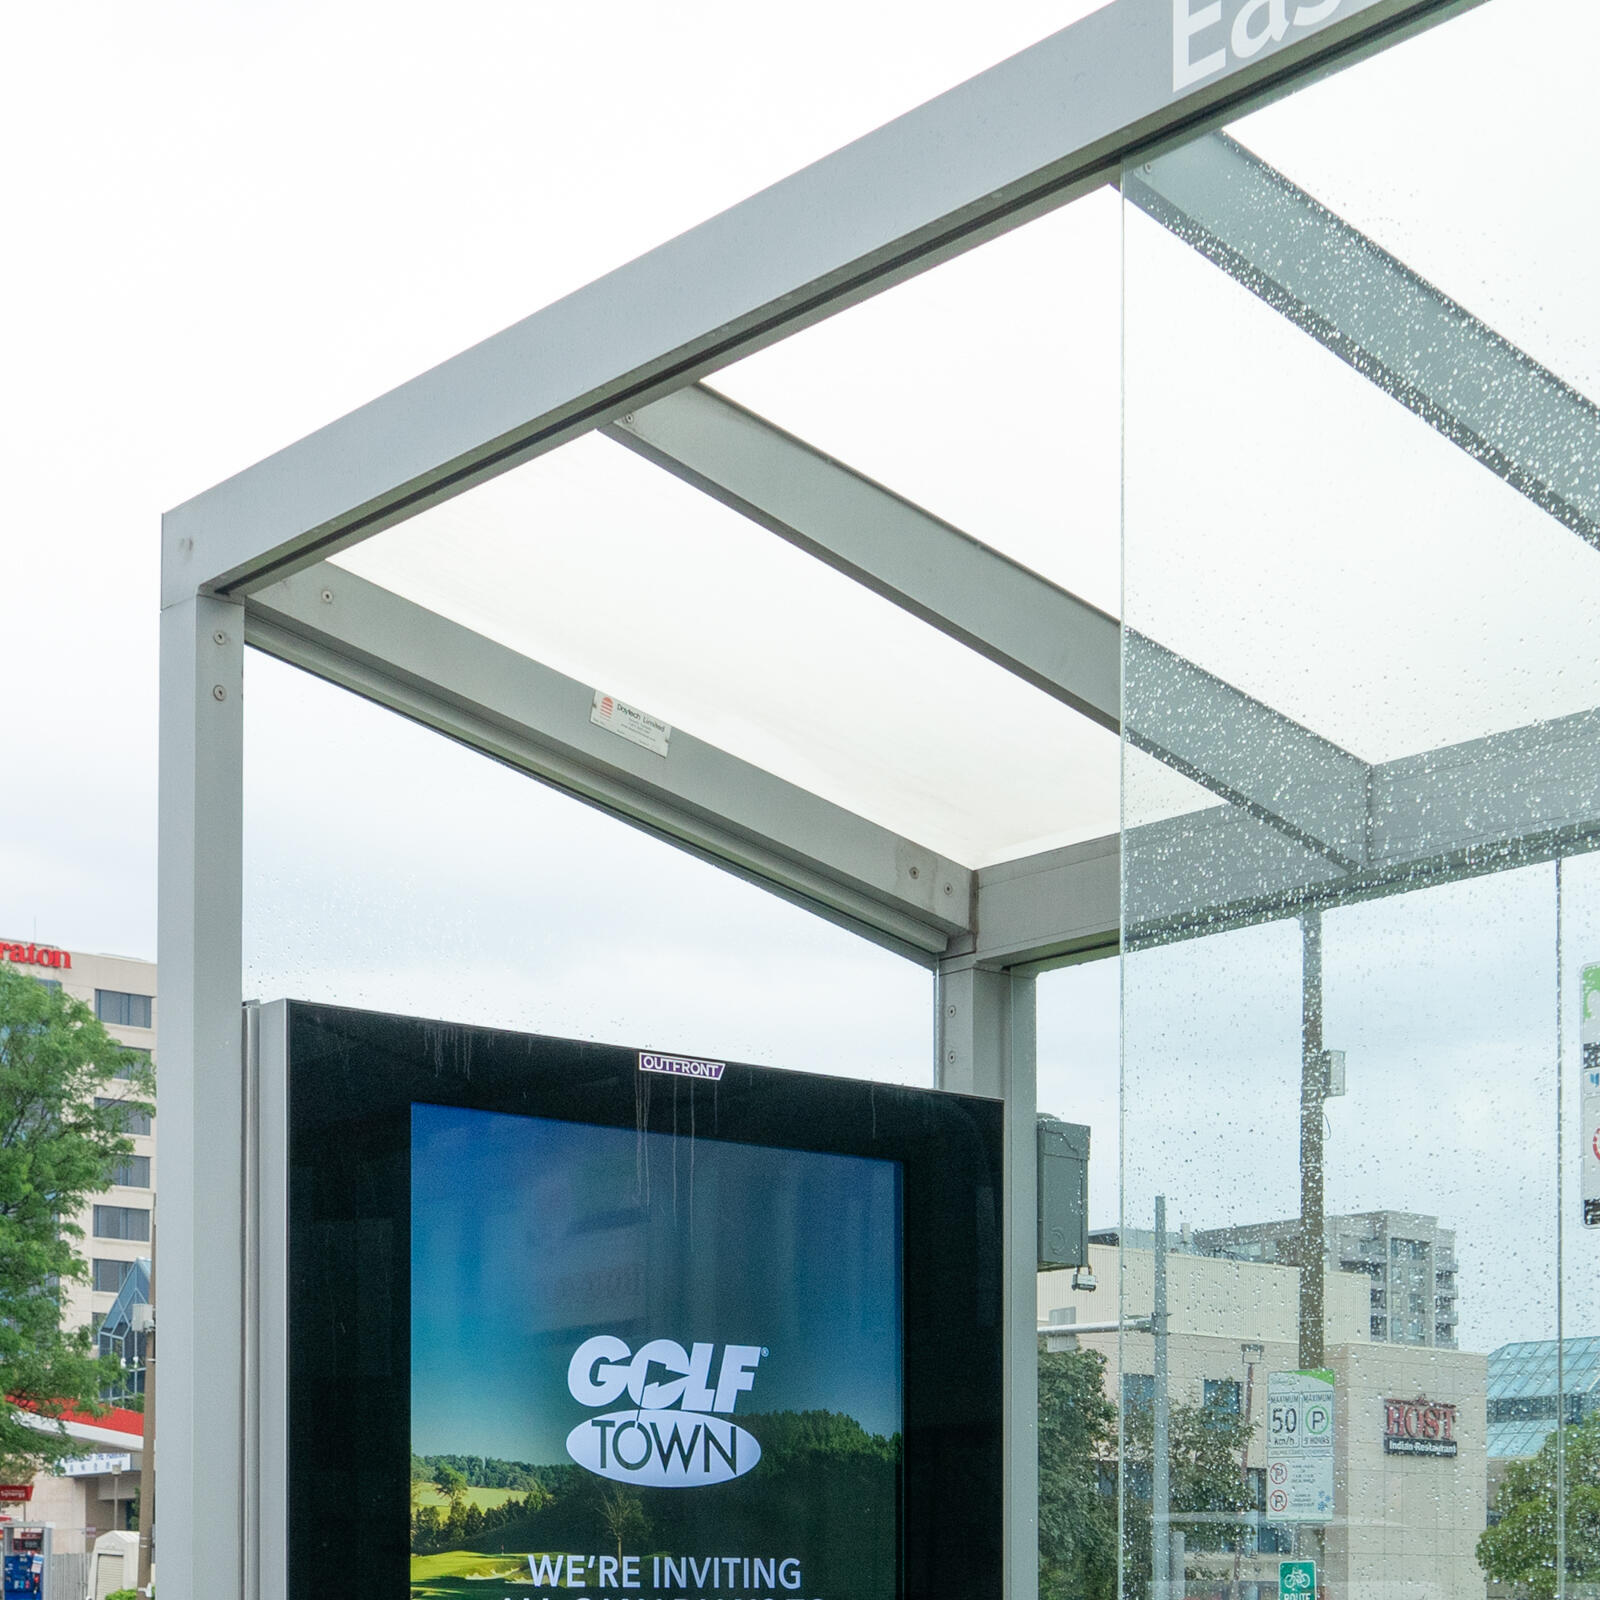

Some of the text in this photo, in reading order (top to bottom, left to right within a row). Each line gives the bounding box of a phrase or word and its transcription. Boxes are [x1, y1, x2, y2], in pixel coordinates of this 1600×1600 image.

[643, 1056, 719, 1077] OUTFRONT
[568, 1335, 761, 1413] GOLF
[1272, 1407, 1297, 1434] 50
[1384, 1404, 1456, 1440] HOST
[591, 1420, 737, 1476] TOWN
[1274, 1436, 1295, 1446] km/h
[1389, 1441, 1457, 1454] Indian Restaurant
[0, 1490, 26, 1499] Synergy
[528, 1554, 801, 1589] WE'RE INVITING
